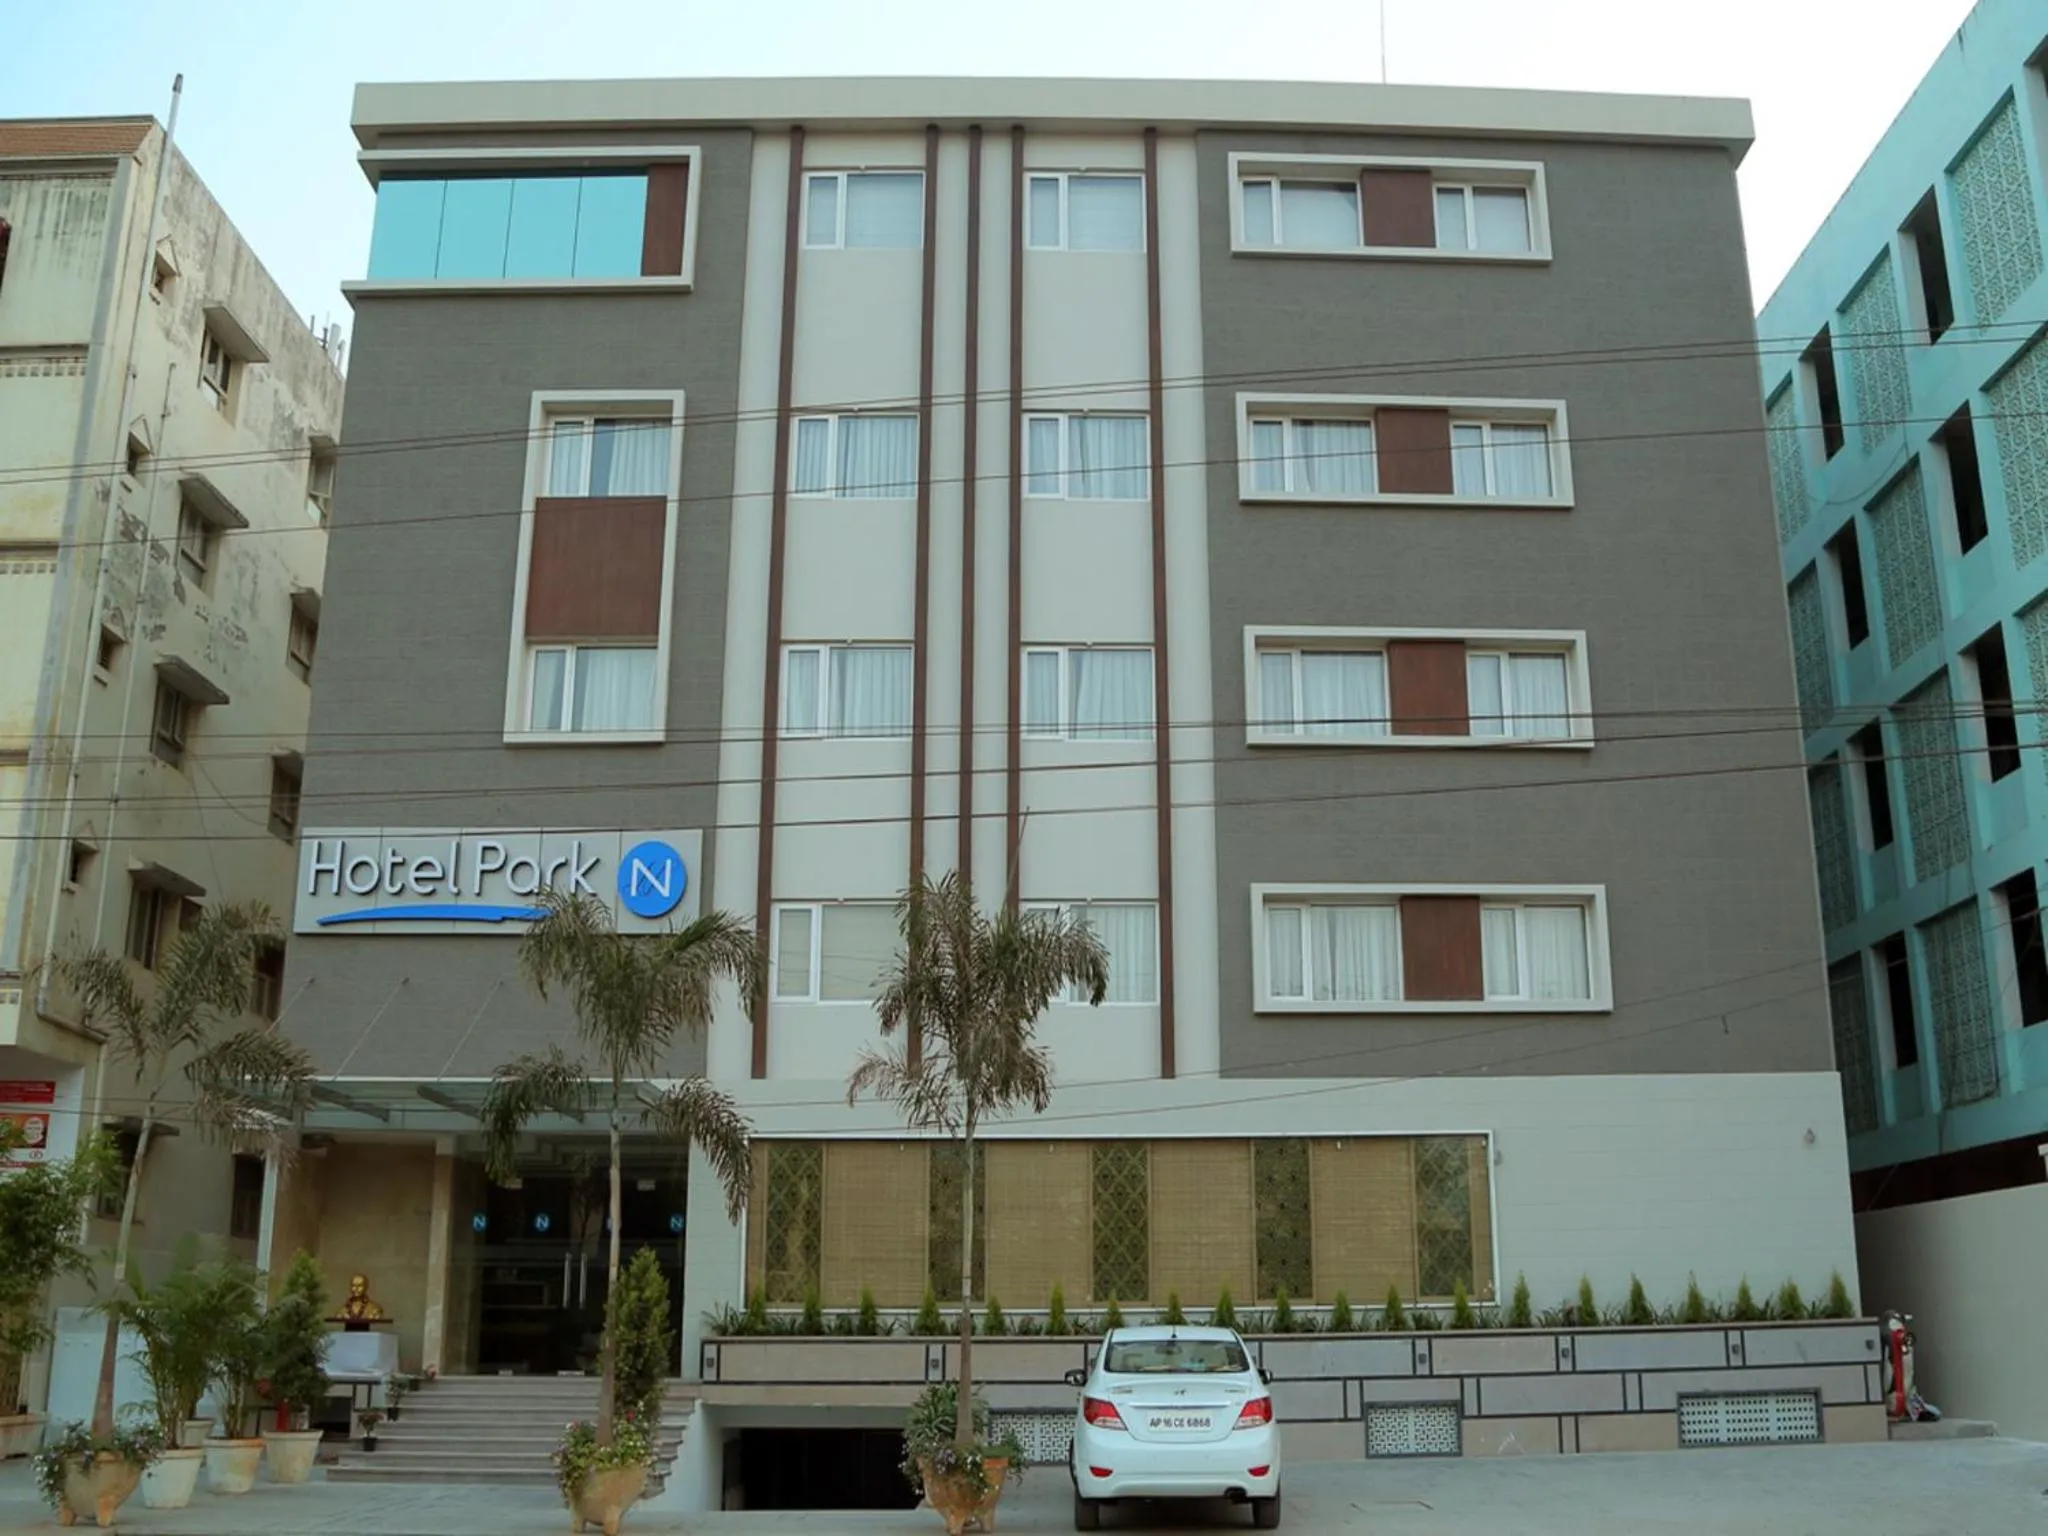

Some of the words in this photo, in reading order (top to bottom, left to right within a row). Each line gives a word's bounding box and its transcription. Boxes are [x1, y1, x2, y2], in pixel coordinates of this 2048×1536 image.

[308, 840, 460, 896] Hotel
[474, 840, 600, 897] Park
[630, 857, 671, 897] N
[1150, 1417, 1161, 1428] AP
